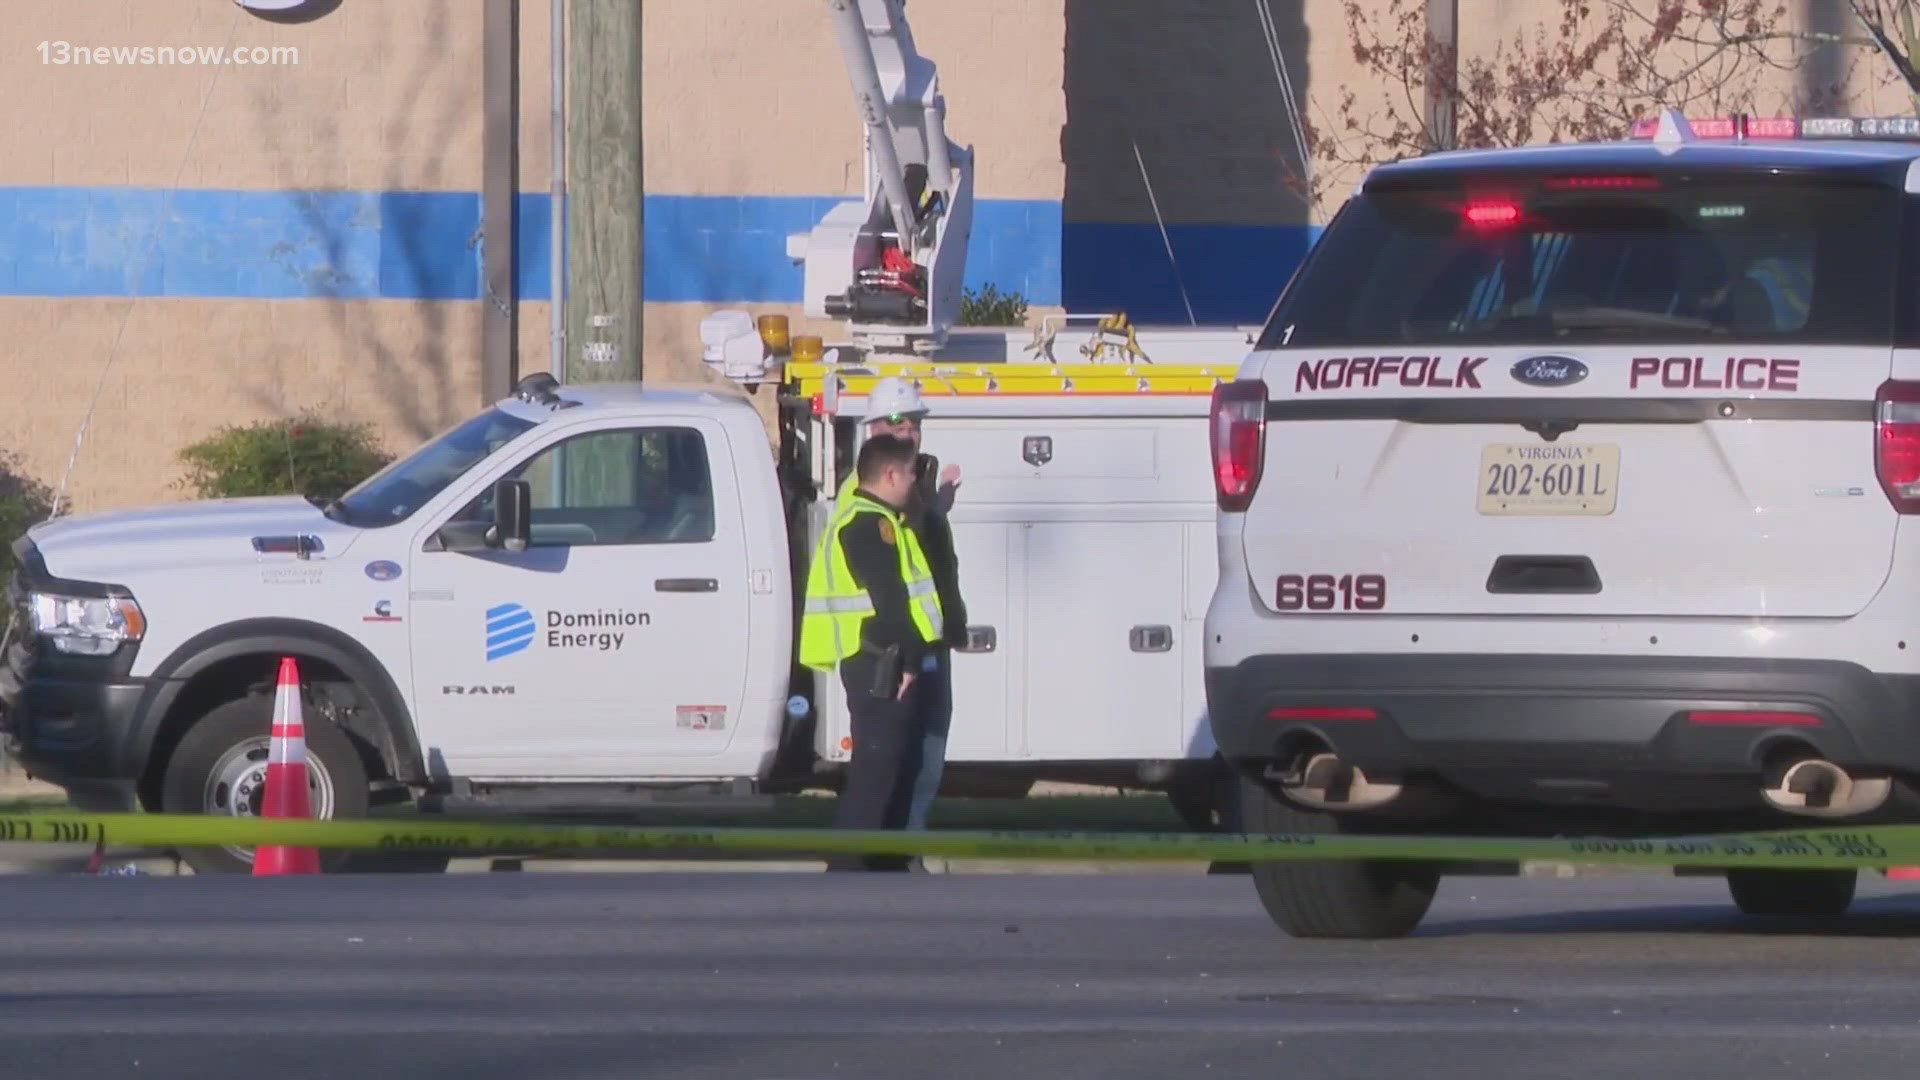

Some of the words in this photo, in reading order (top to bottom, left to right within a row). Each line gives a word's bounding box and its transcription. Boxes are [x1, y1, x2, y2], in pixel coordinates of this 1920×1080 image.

[1295, 356, 1488, 393] NORFOLK
[1525, 360, 1569, 379] Ford
[1629, 357, 1800, 391] POLICE
[1518, 447, 1583, 460] VIRGINIA
[1276, 574, 1386, 611] 6619
[547, 609, 651, 627] Dominion
[547, 630, 625, 651] Energy
[442, 685, 516, 695] RAM
